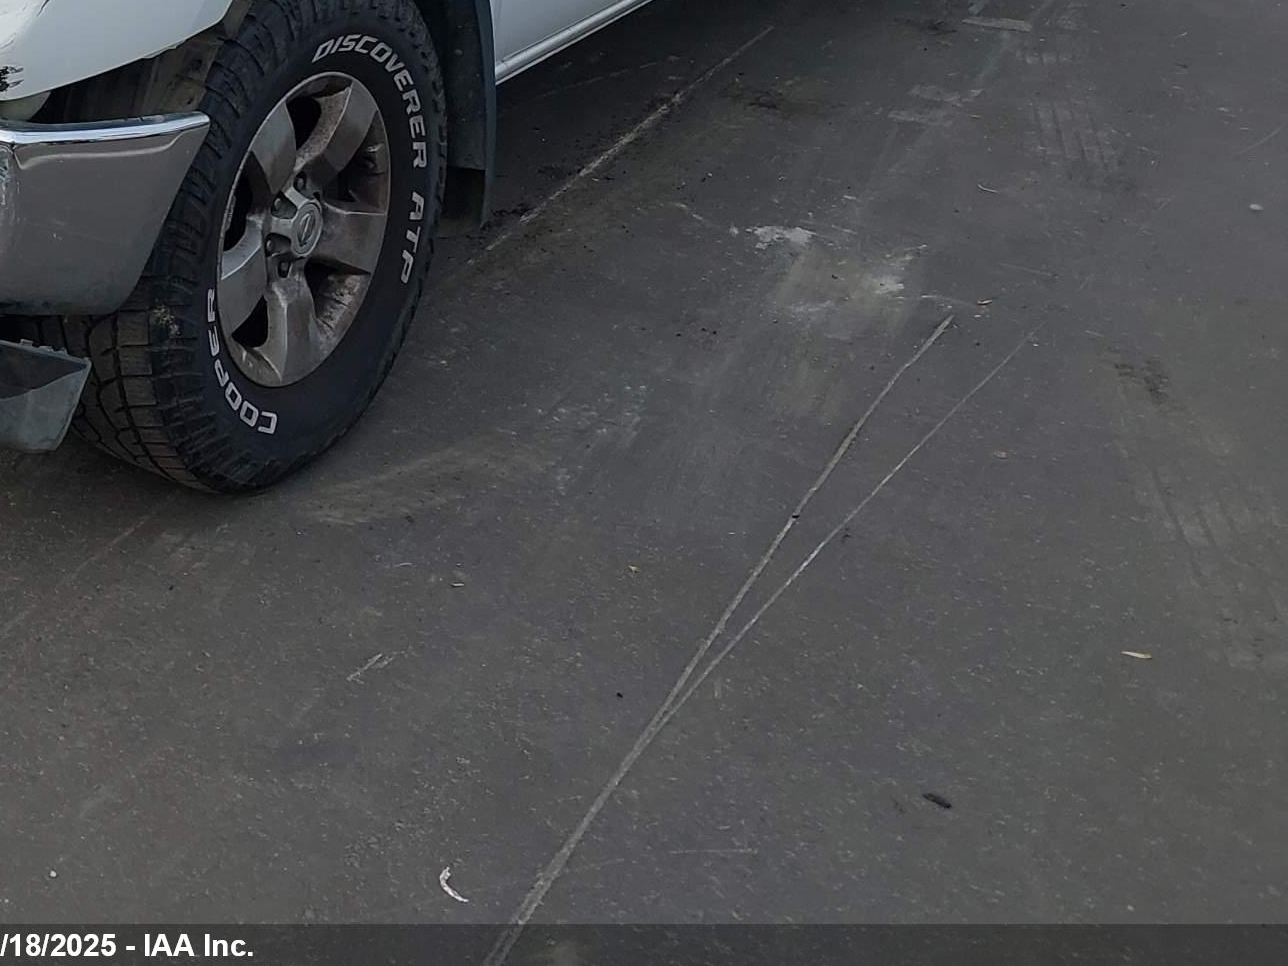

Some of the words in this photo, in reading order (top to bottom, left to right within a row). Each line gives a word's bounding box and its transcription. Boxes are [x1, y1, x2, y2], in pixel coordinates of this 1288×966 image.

[312, 34, 428, 169] DISCOVERER
[401, 191, 425, 284] ATP
[207, 288, 278, 434] COOPER
